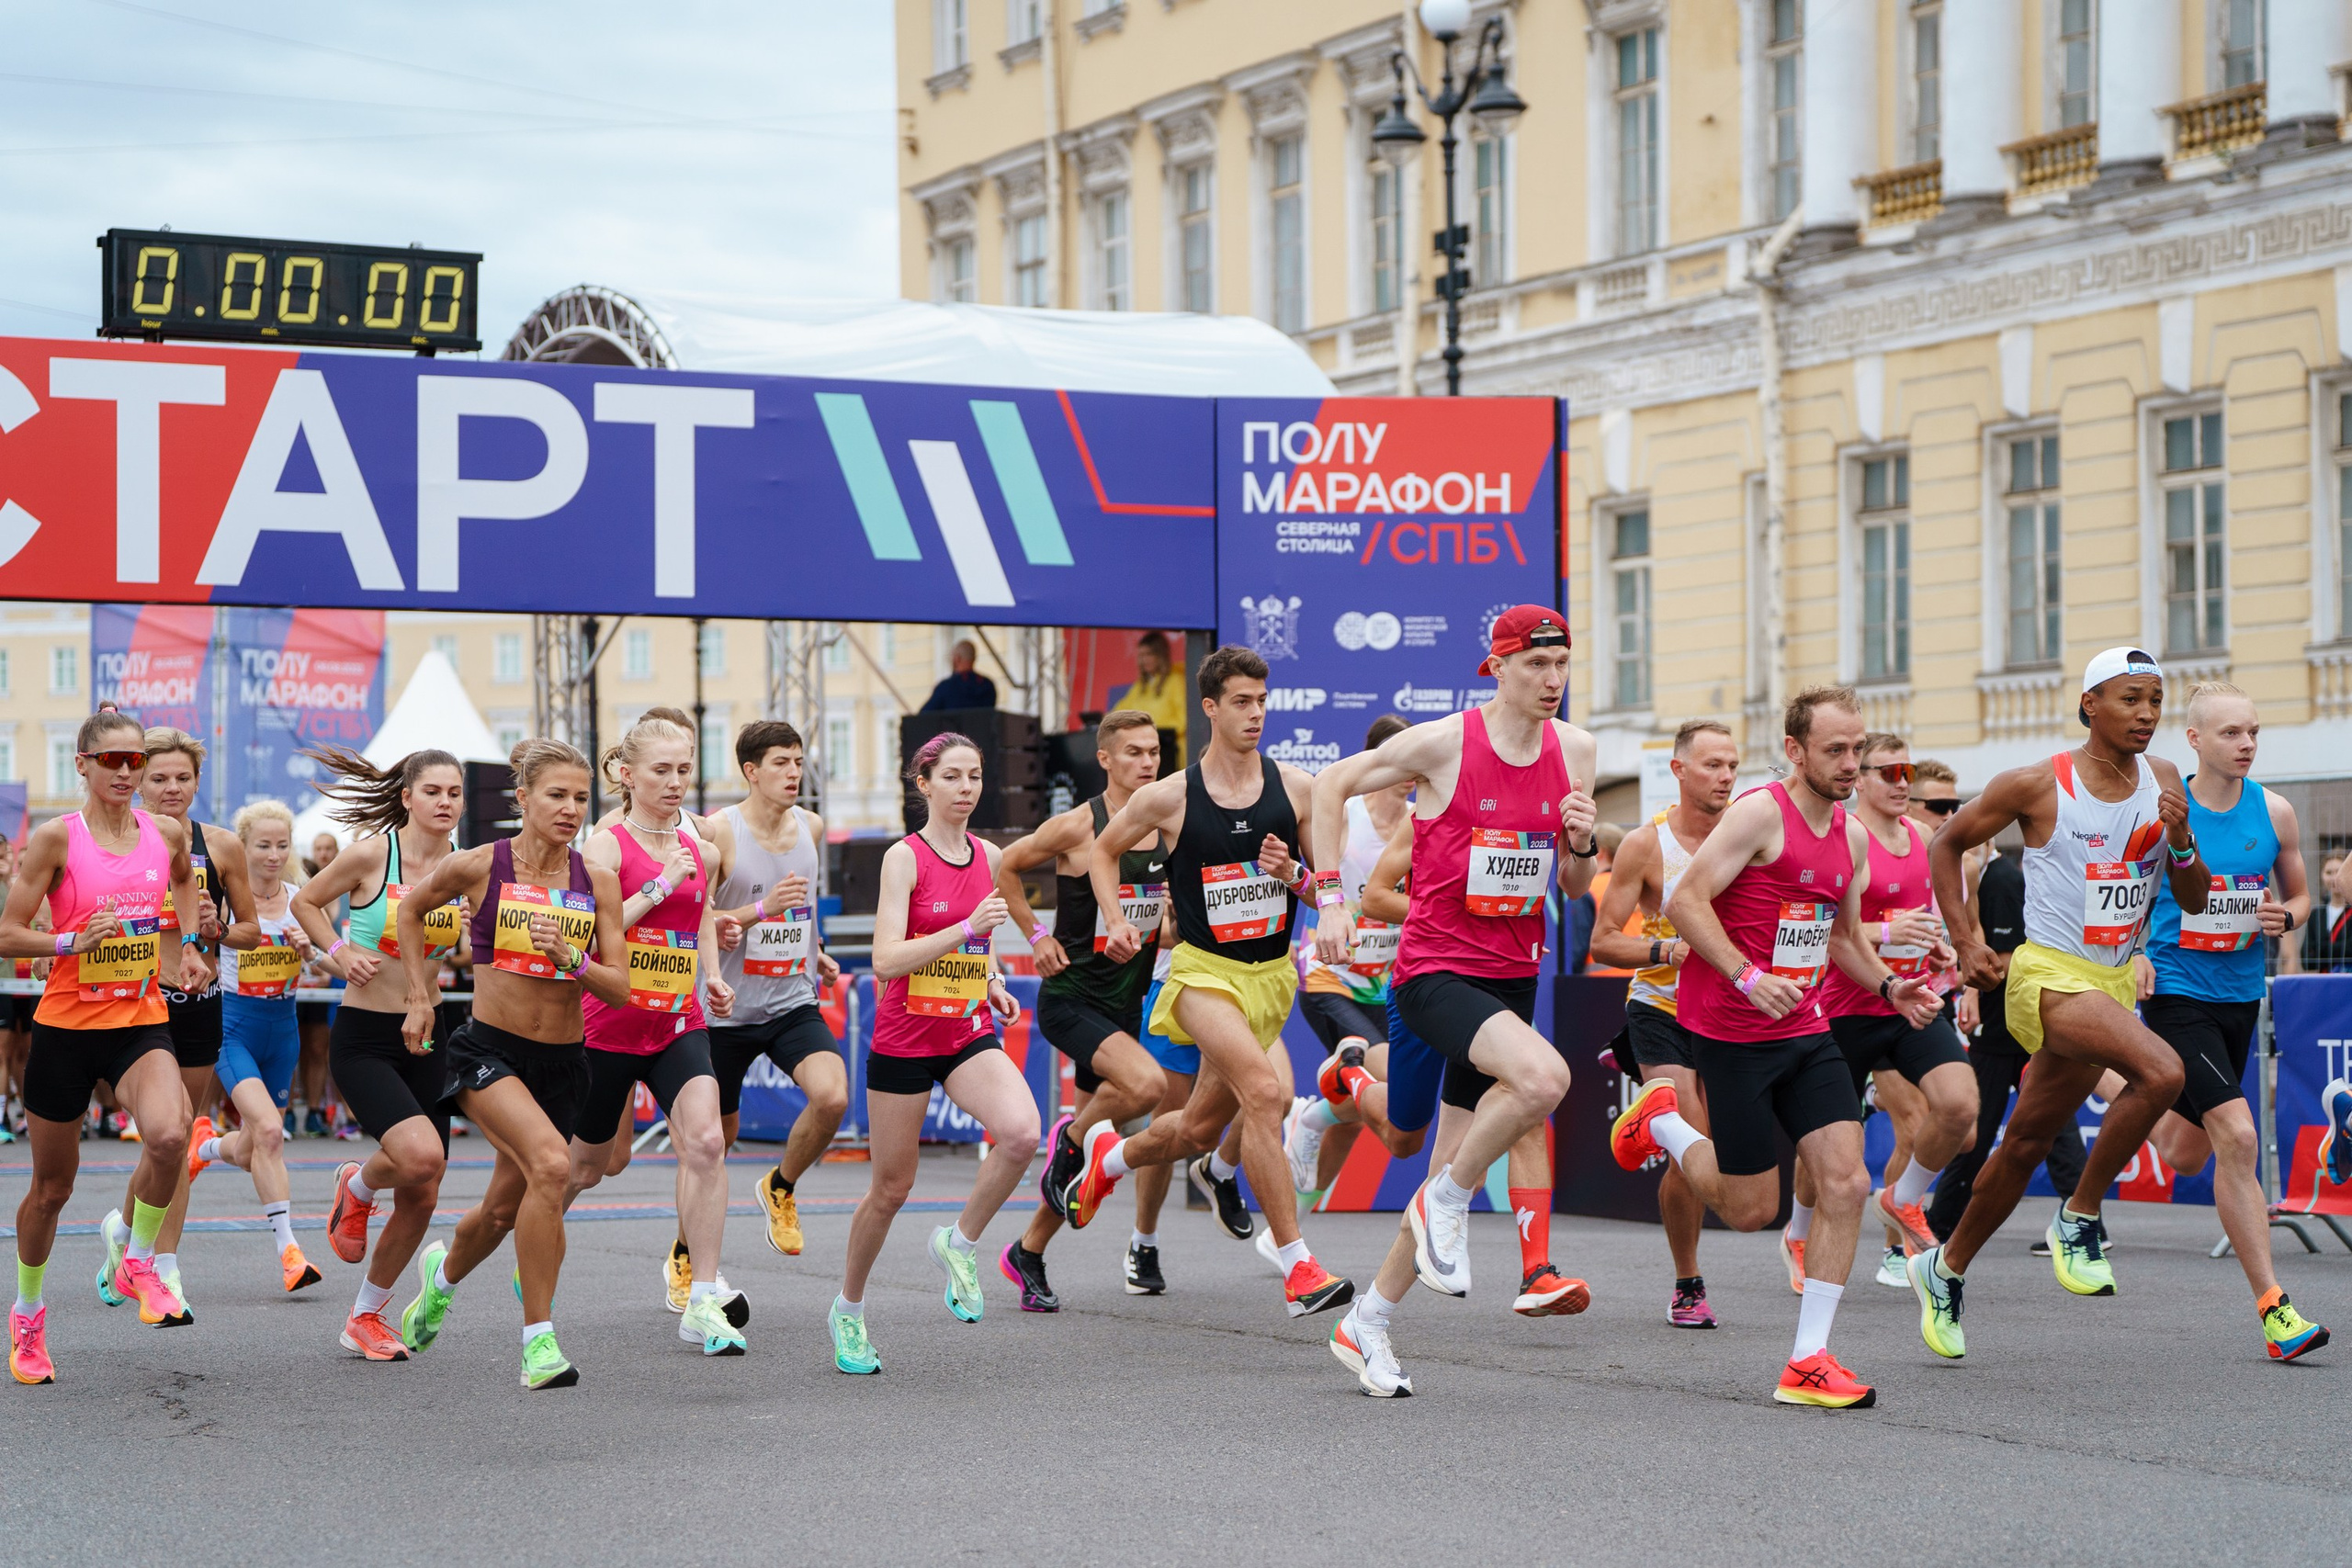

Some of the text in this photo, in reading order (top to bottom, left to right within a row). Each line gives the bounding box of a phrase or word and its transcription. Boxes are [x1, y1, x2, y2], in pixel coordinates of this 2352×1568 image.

[1243, 422, 1388, 465] ПОЛУ
[0, 356, 755, 599] ТАРТ
[1243, 471, 1511, 514] МАРАФОН
[1276, 522, 1361, 536] СЕВЕРНАЯ
[1276, 538, 1355, 554] СТОЛИЦА
[97, 651, 152, 680] ПОЛУ
[242, 649, 311, 678] ПОЛУ
[97, 678, 197, 707] МАРАФОН
[241, 678, 368, 711] МАРАФОН
[1265, 688, 1327, 711] МИР
[1484, 835, 1515, 843] МАРАФОН
[1212, 869, 1239, 877] МАРАФОН
[1486, 855, 1540, 879] ХУДЕЕВ
[513, 889, 545, 899] МАРАФОН
[2098, 882, 2147, 910] 7003
[565, 899, 588, 910] 2023
[1123, 903, 1159, 919] УГЛОВ
[2201, 897, 2258, 915] БАЛКИН
[638, 932, 663, 941] МАРАФОН
[679, 940, 694, 948] 2023
[761, 928, 802, 944] ЖАРОВ
[630, 949, 692, 975] БОЙНОВА
[653, 979, 669, 987] 7023
[944, 986, 960, 994] 7024
